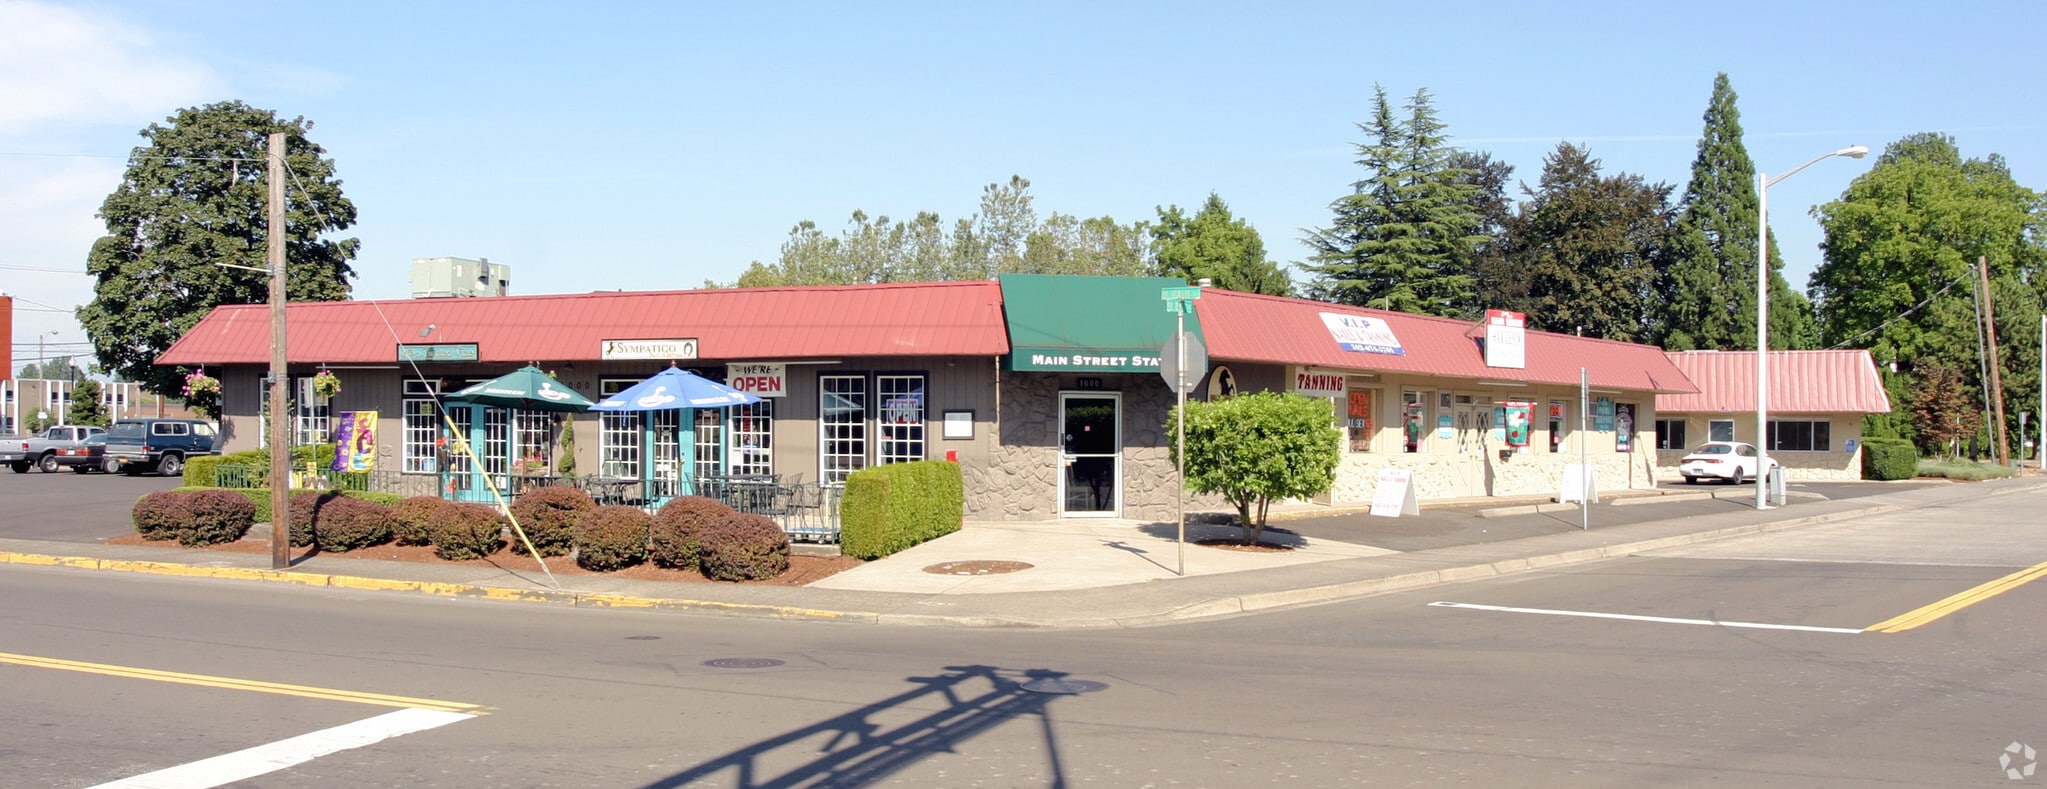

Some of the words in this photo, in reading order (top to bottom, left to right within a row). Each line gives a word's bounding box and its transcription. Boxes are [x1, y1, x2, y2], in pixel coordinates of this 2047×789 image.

[1032, 354, 1068, 366] MAIN
[1072, 354, 1127, 367] STREET
[1132, 355, 1162, 367] STA
[743, 365, 773, 374] WE'RE
[732, 376, 781, 392] OPEN
[1297, 373, 1344, 391] TANNING
[889, 402, 917, 423] OPEN
